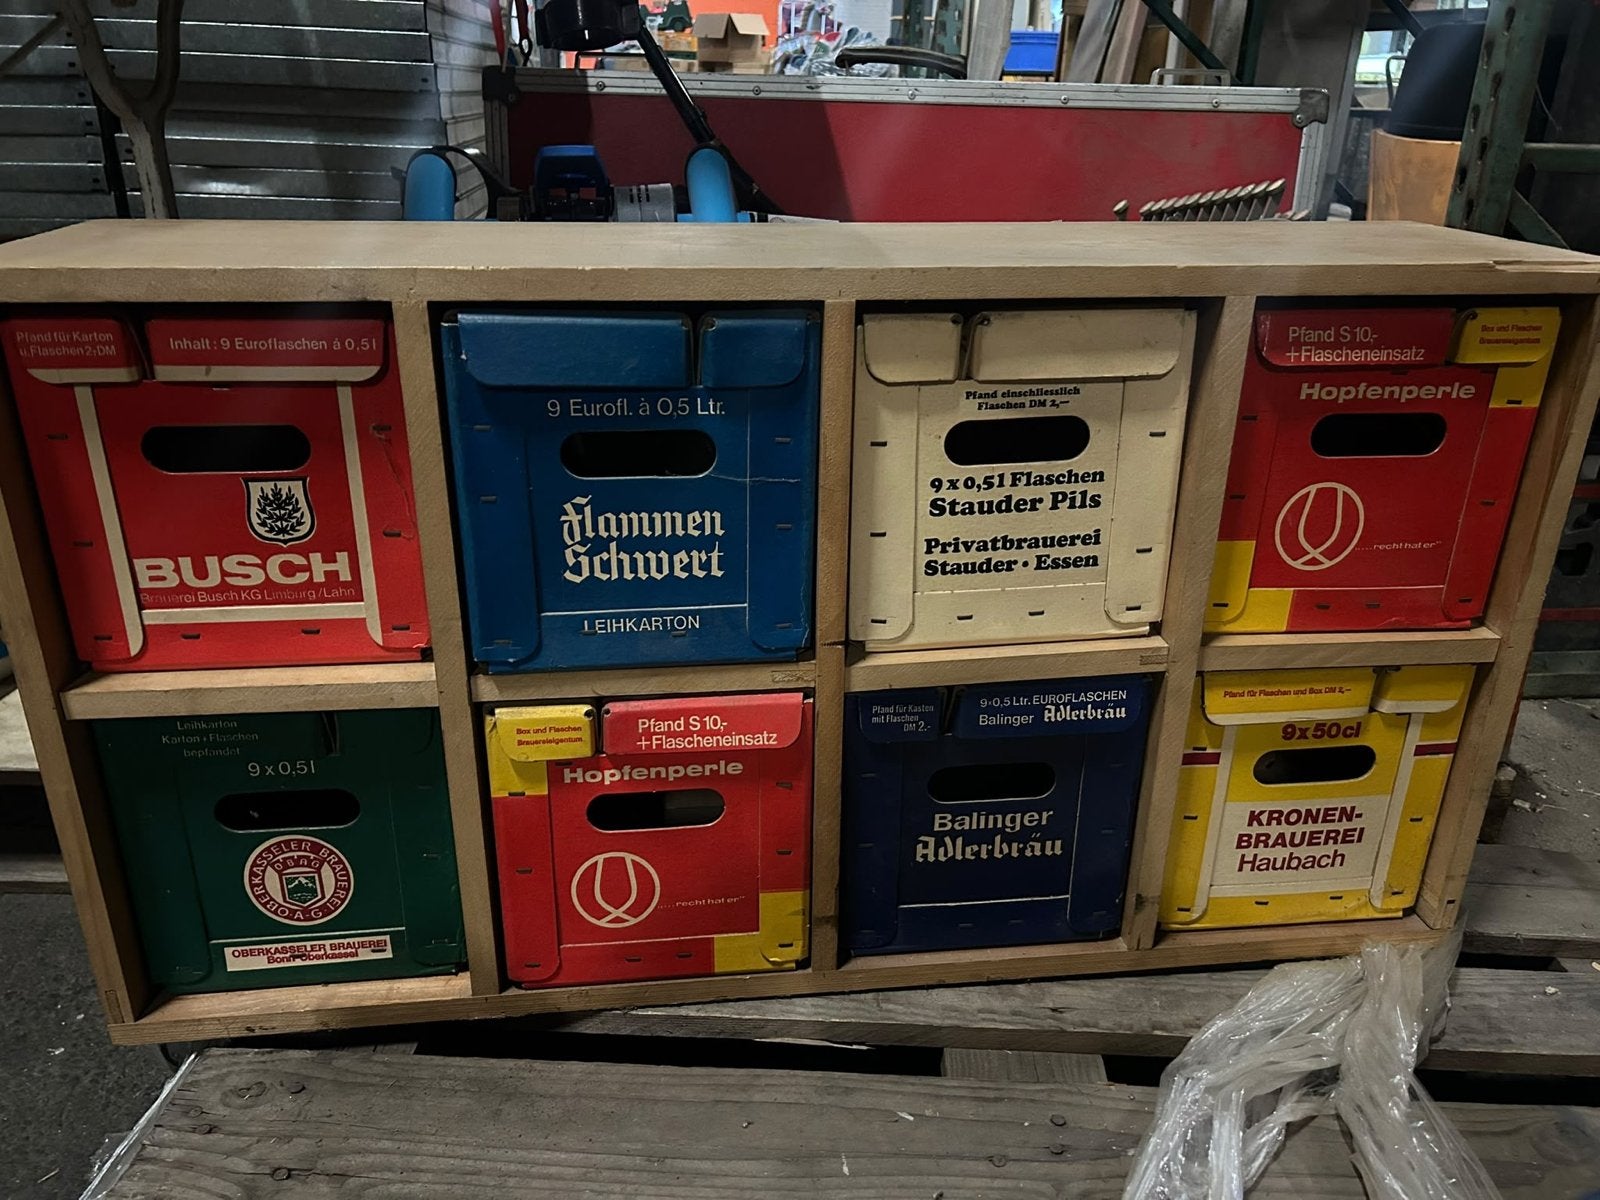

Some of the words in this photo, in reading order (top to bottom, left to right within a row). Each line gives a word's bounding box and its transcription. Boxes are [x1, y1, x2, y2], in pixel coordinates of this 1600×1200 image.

[53, 331, 70, 342] für
[72, 331, 113, 342] Karton
[1288, 326, 1334, 342] Pfand
[1339, 326, 1350, 341] S
[220, 337, 231, 350] 9
[235, 337, 327, 351] Euroflaschen
[1285, 346, 1425, 362] +Flascheneinsatz
[965, 390, 997, 400] Pfand
[1001, 386, 1081, 398] einschliesslich
[1300, 382, 1476, 403] Hopfenperle
[547, 399, 561, 417] 9
[570, 398, 633, 416] Eurofl.
[639, 397, 650, 416] à
[657, 397, 690, 419] 0,5
[697, 397, 726, 415] Ltr.
[977, 401, 1026, 410] Flaschen
[1029, 399, 1047, 408] DM
[1009, 468, 1105, 488] Flaschen
[929, 494, 1044, 517] Stauder
[1049, 489, 1102, 511] Pils
[560, 495, 725, 546] Flammen
[924, 529, 1102, 554] Privatbrauerei
[133, 551, 352, 588] BUSCH
[563, 541, 725, 583] Schwert
[924, 557, 1018, 576] Stauder
[1034, 554, 1099, 571] Essen
[198, 591, 239, 602] Busch
[241, 590, 262, 600] KG
[584, 615, 700, 633] LEIHKARTON
[1013, 696, 1031, 706] Ltr.
[1033, 690, 1127, 705] EUROFLASCHEN
[1223, 690, 1245, 698] Pfand
[1247, 689, 1257, 697] für
[1258, 688, 1291, 697] Flaschen
[1308, 687, 1323, 695] Box
[872, 705, 894, 714] Pfand
[895, 704, 906, 712] für
[908, 704, 934, 713] Kasten
[979, 714, 1035, 727] Balinger
[1043, 702, 1127, 722] Adlerbräu
[177, 720, 238, 731] Leihkarton
[638, 716, 684, 733] Pfand
[689, 717, 700, 731] S
[872, 715, 885, 723] mit
[886, 714, 919, 723] Flaschen
[903, 723, 916, 732] DM
[162, 735, 200, 744] Karton
[209, 732, 259, 742] Flaschen
[549, 725, 582, 733] Flaschen
[637, 732, 778, 750] +Flascheneinsatz
[563, 760, 744, 785] Hopfenperle
[933, 811, 1053, 833] Balinger
[1247, 805, 1363, 827] KRONEN-
[1235, 827, 1365, 849] BRAUEREI
[915, 832, 1063, 863] Adlerbräu
[1237, 849, 1346, 872] Haubach
[251, 840, 311, 917] OBERKASSELER
[319, 847, 349, 910] BRAUEREI
[231, 942, 326, 958] OBERKASSELER
[330, 939, 388, 951] BRAUEREI
